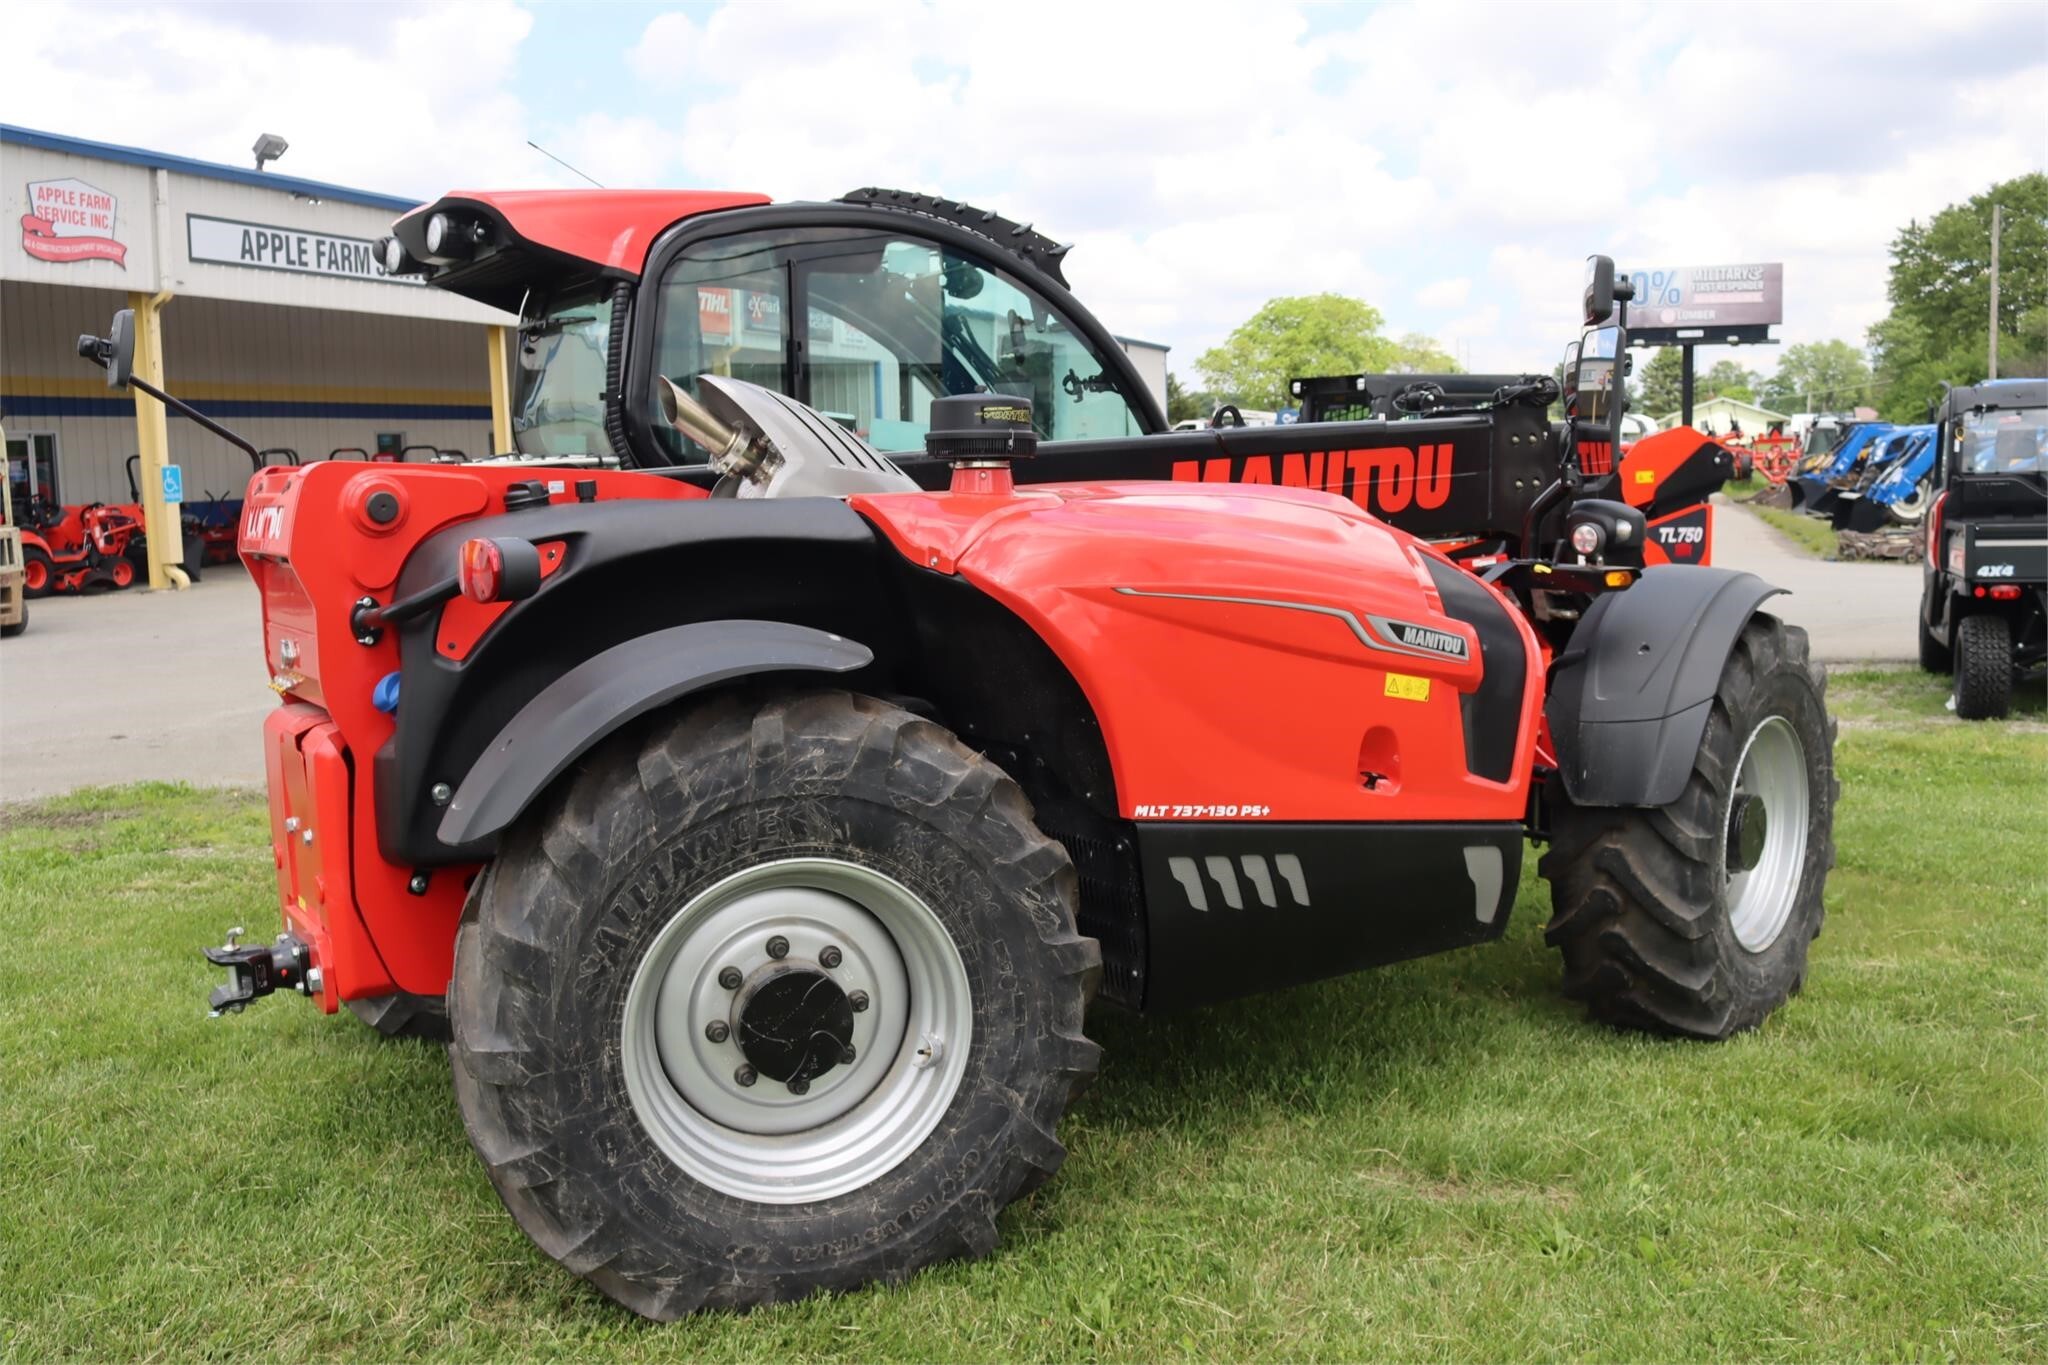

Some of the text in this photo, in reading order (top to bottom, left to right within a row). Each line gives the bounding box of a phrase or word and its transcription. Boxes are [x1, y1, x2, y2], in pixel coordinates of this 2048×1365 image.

[37, 186, 112, 212] APPLE FARM
[36, 205, 112, 230] SERVICE INC.
[240, 228, 309, 267] APPLE
[315, 239, 371, 275] FARM
[1614, 271, 1681, 306] 0%
[698, 291, 729, 314] TIHL
[1659, 526, 1704, 544] TL750
[1403, 626, 1463, 653] MANITOU
[1134, 805, 1271, 817] MLT 737-130 PS+
